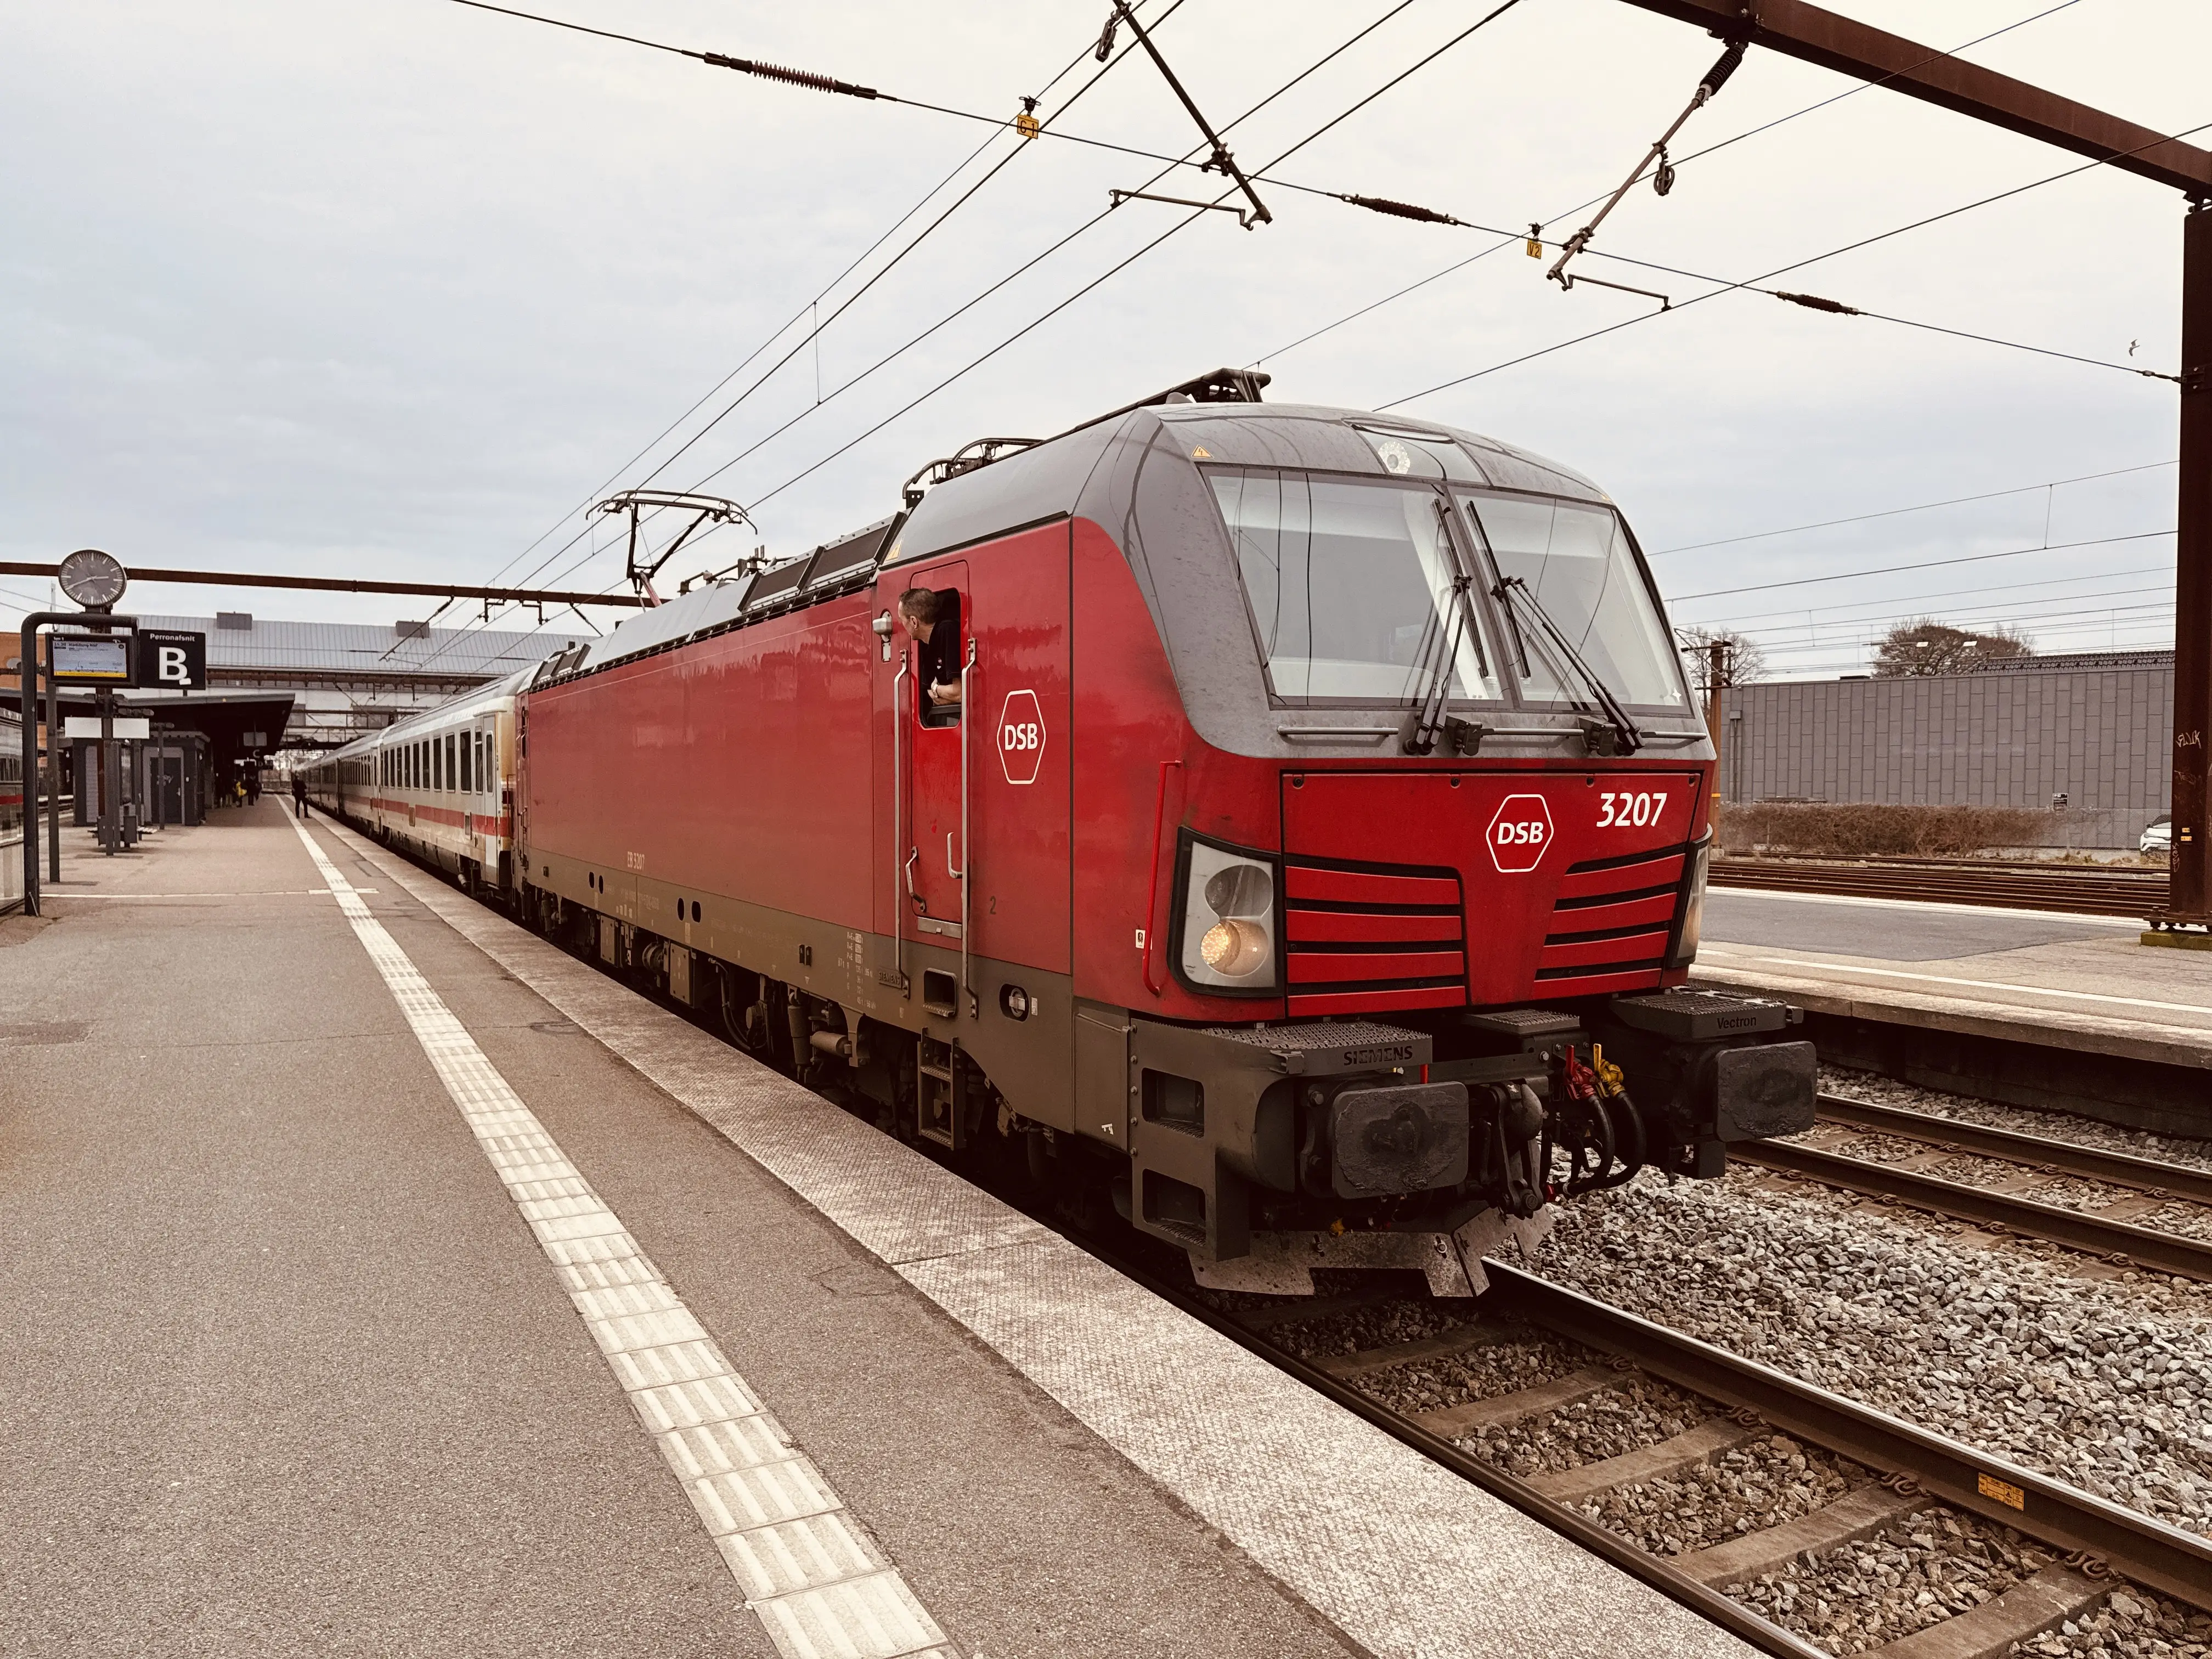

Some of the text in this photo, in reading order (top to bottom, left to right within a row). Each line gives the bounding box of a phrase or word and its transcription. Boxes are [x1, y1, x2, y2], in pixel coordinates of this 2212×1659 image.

[1529, 243, 1540, 258] V2
[150, 633, 196, 642] Perronafsnit
[159, 646, 188, 680] B
[1005, 723, 1038, 751] DSB
[1596, 792, 1668, 827] 3207
[1497, 822, 1544, 845] DSB
[634, 852, 645, 871] 3207
[990, 896, 997, 915] 2
[878, 972, 900, 986] SIEMENS
[1717, 1017, 1757, 1029] Vectron
[1344, 1045, 1413, 1066] SIEMENS
